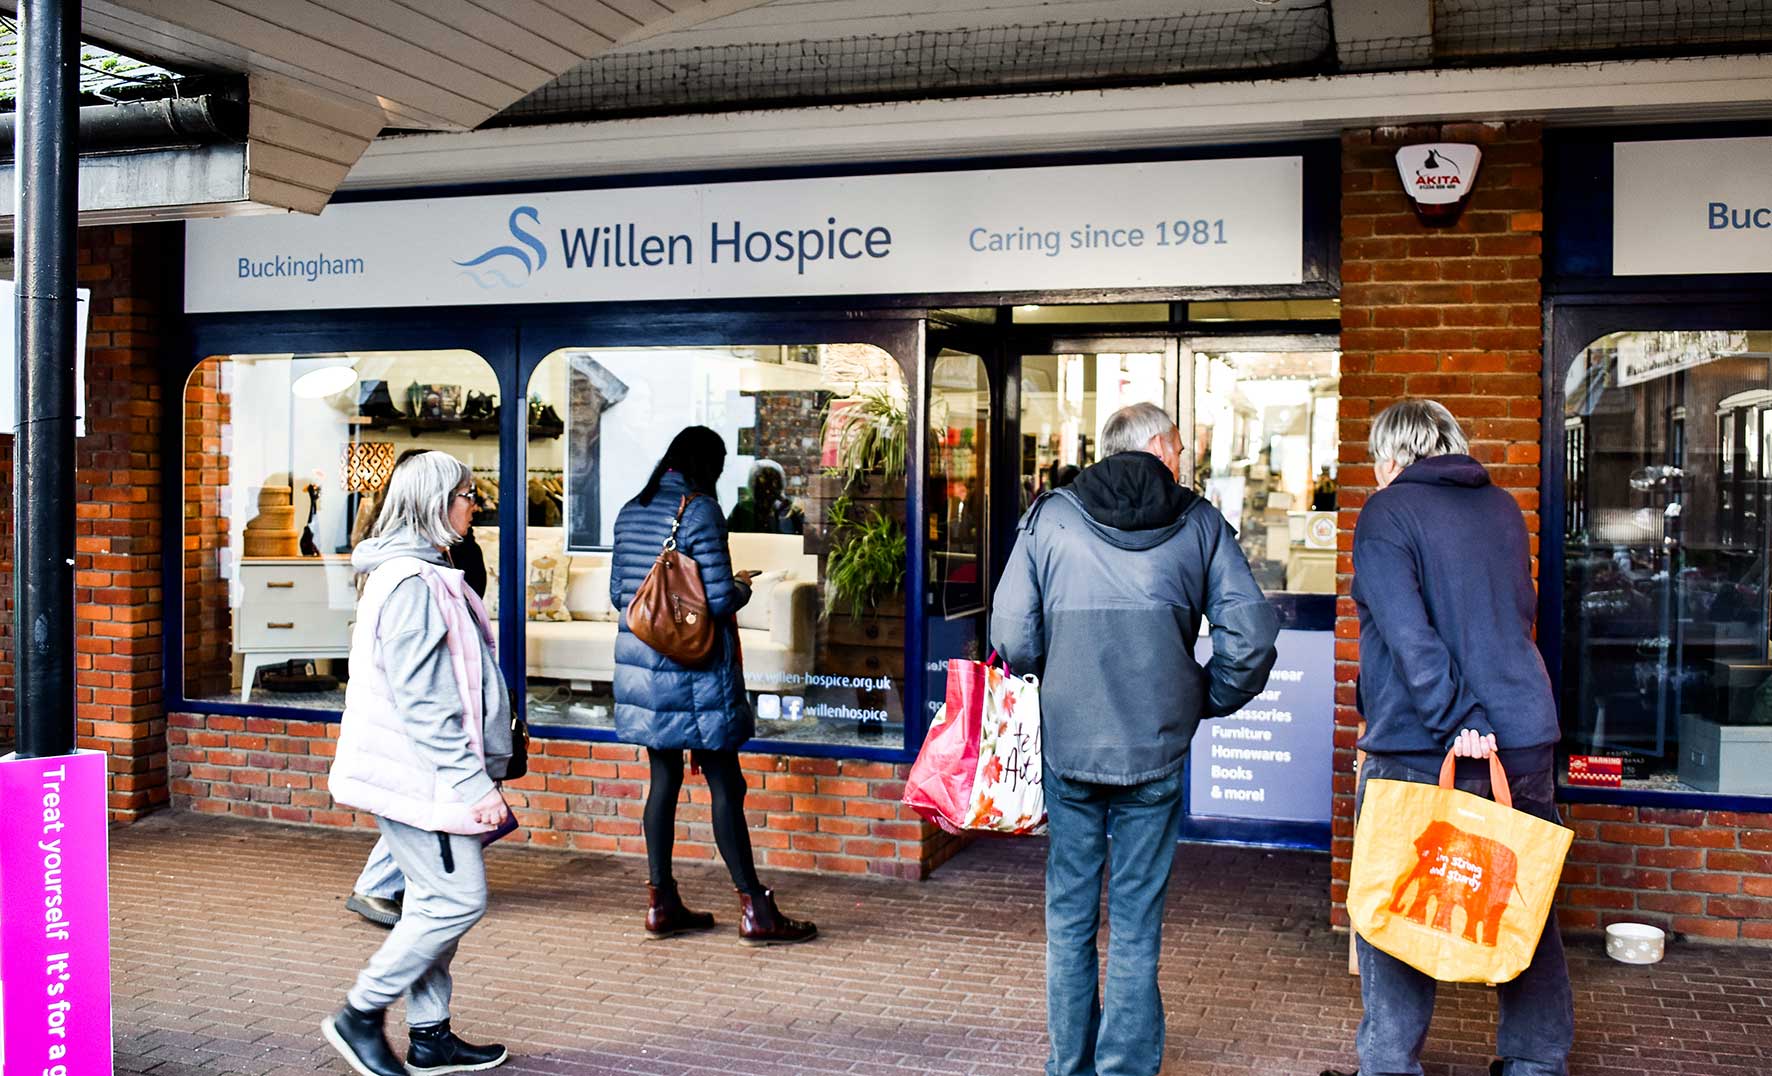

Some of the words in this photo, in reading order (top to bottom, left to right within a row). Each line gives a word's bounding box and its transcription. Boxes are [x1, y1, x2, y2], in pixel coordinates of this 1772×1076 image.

[1416, 175, 1461, 185] AKITA
[1708, 202, 1772, 230] Buc
[560, 223, 693, 269] Willen
[711, 217, 893, 275] Hospice
[968, 227, 1061, 257] Caring
[1070, 224, 1145, 249] since
[1156, 219, 1228, 246] 1981
[237, 253, 364, 282] Buckingham
[806, 703, 888, 722] willenhospice
[1211, 725, 1273, 741] Furniture
[1211, 744, 1292, 763] Homewares
[1587, 756, 1622, 766] WARNING
[1211, 765, 1254, 781] Books
[42, 764, 65, 835] Treat
[1211, 785, 1222, 800] &
[1224, 788, 1265, 802] more!
[1429, 862, 1447, 877] and
[1446, 872, 1482, 893] sturdy
[1450, 856, 1483, 879] strong
[38, 839, 70, 941] yourself
[46, 952, 71, 997] It's
[48, 1001, 71, 1038] for
[49, 1043, 67, 1060] a
